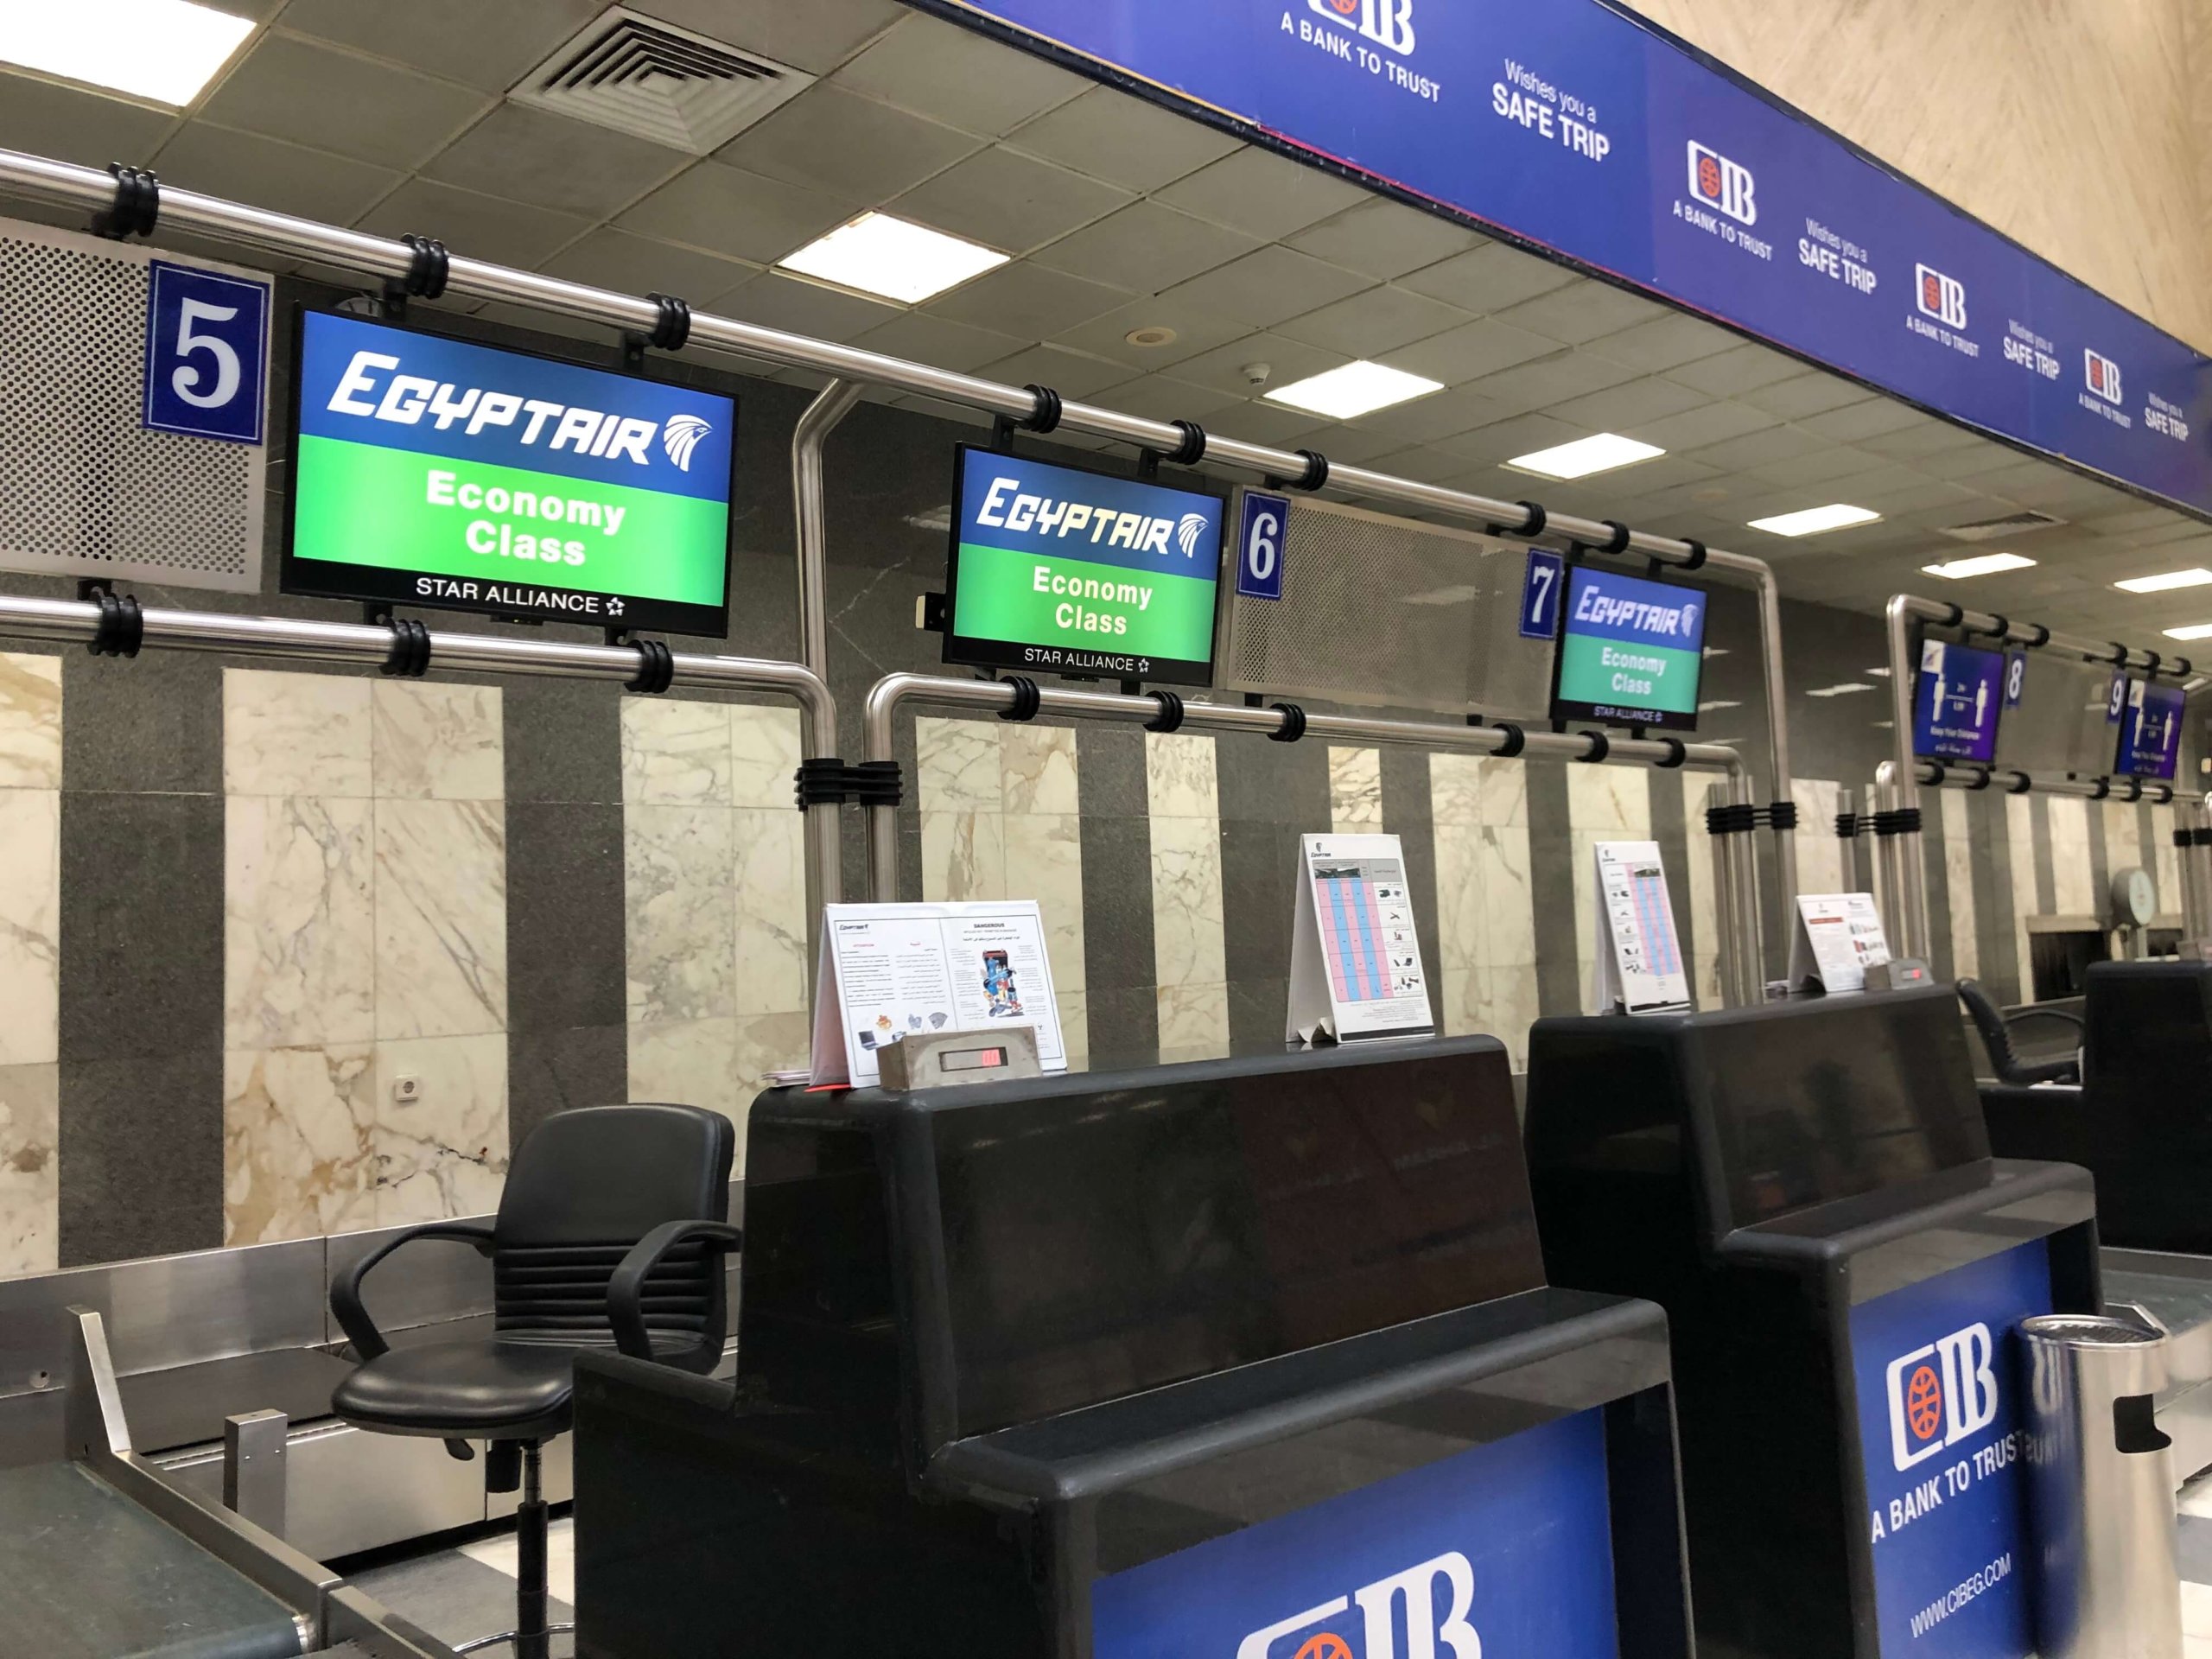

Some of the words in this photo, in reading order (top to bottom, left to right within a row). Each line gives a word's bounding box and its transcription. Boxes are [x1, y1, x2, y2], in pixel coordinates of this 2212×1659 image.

[1281, 11, 1294, 35] A
[1300, 19, 1351, 61] BANK
[1357, 47, 1381, 74] TO
[1385, 60, 1440, 102] TRUST
[1504, 58, 1556, 103] Wishes
[1559, 92, 1585, 117] you
[1587, 106, 1597, 124] a
[1492, 82, 1554, 139] SAFE
[1558, 114, 1610, 162] TRIP
[1687, 139, 1757, 226] CIB
[1673, 200, 1682, 218] A
[1684, 205, 1718, 235] BANK
[1719, 222, 1736, 243] TO
[1737, 231, 1772, 261] TRUST
[1799, 238, 1840, 279] SAFE
[1840, 258, 1877, 295] TRIP
[172, 298, 240, 409] 5
[2004, 335, 2034, 371] SAFE
[2034, 351, 2060, 381] TRIP
[327, 350, 658, 465] EGYPTAIR
[2145, 407, 2169, 435] SAFE
[426, 468, 626, 536] Economy
[976, 476, 1176, 556] EGYPTAIR
[465, 520, 586, 567] Class
[1249, 512, 1278, 581] 6
[416, 577, 479, 601] STAR
[486, 581, 599, 614] ALLIANCE
[1033, 565, 1154, 611] Economy
[1532, 566, 1554, 623] 7
[1574, 585, 1682, 636] EGYPTAIR
[1055, 602, 1128, 635] Class
[1024, 648, 1062, 664] STAR
[1065, 652, 1134, 671] ALLIANCE
[1601, 647, 1667, 677] Economy
[1611, 672, 1652, 695] Class
[2008, 658, 2023, 699] 8
[1594, 705, 1615, 717] STAR
[1616, 709, 1655, 722] ALLIANCE
[2110, 679, 2123, 715] 9
[1887, 1322, 1999, 1472] CIB
[1871, 1510, 1885, 1544] A
[1890, 1476, 1943, 1533] BANK
[1944, 1465, 1970, 1498] TO
[1973, 1430, 2020, 1480] TRUS
[1910, 1552, 2012, 1638] WWW.CIBEG.COM
